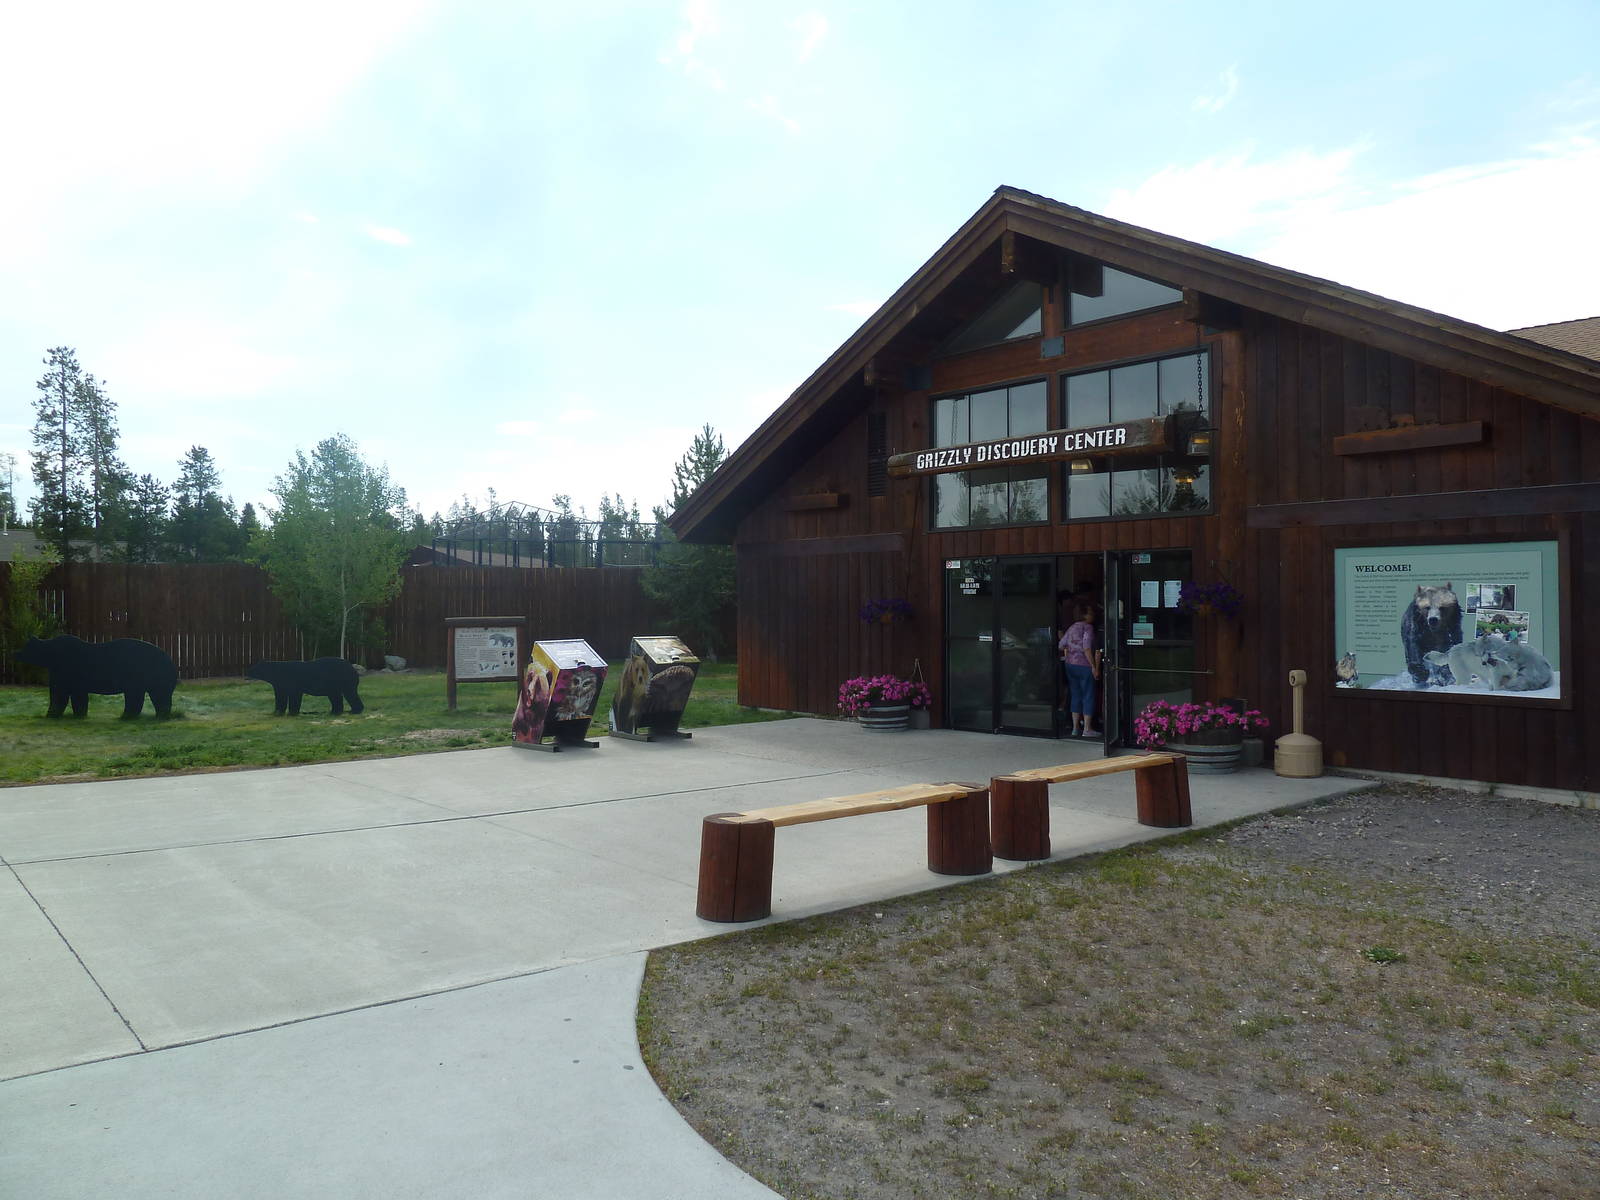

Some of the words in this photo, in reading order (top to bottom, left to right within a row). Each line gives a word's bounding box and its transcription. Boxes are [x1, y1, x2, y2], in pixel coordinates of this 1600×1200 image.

[917, 448, 971, 469] GRIZZLY
[978, 437, 1058, 461] DISCOVERY
[1065, 428, 1126, 451] CENTER
[1356, 564, 1411, 573] WELCOME!
